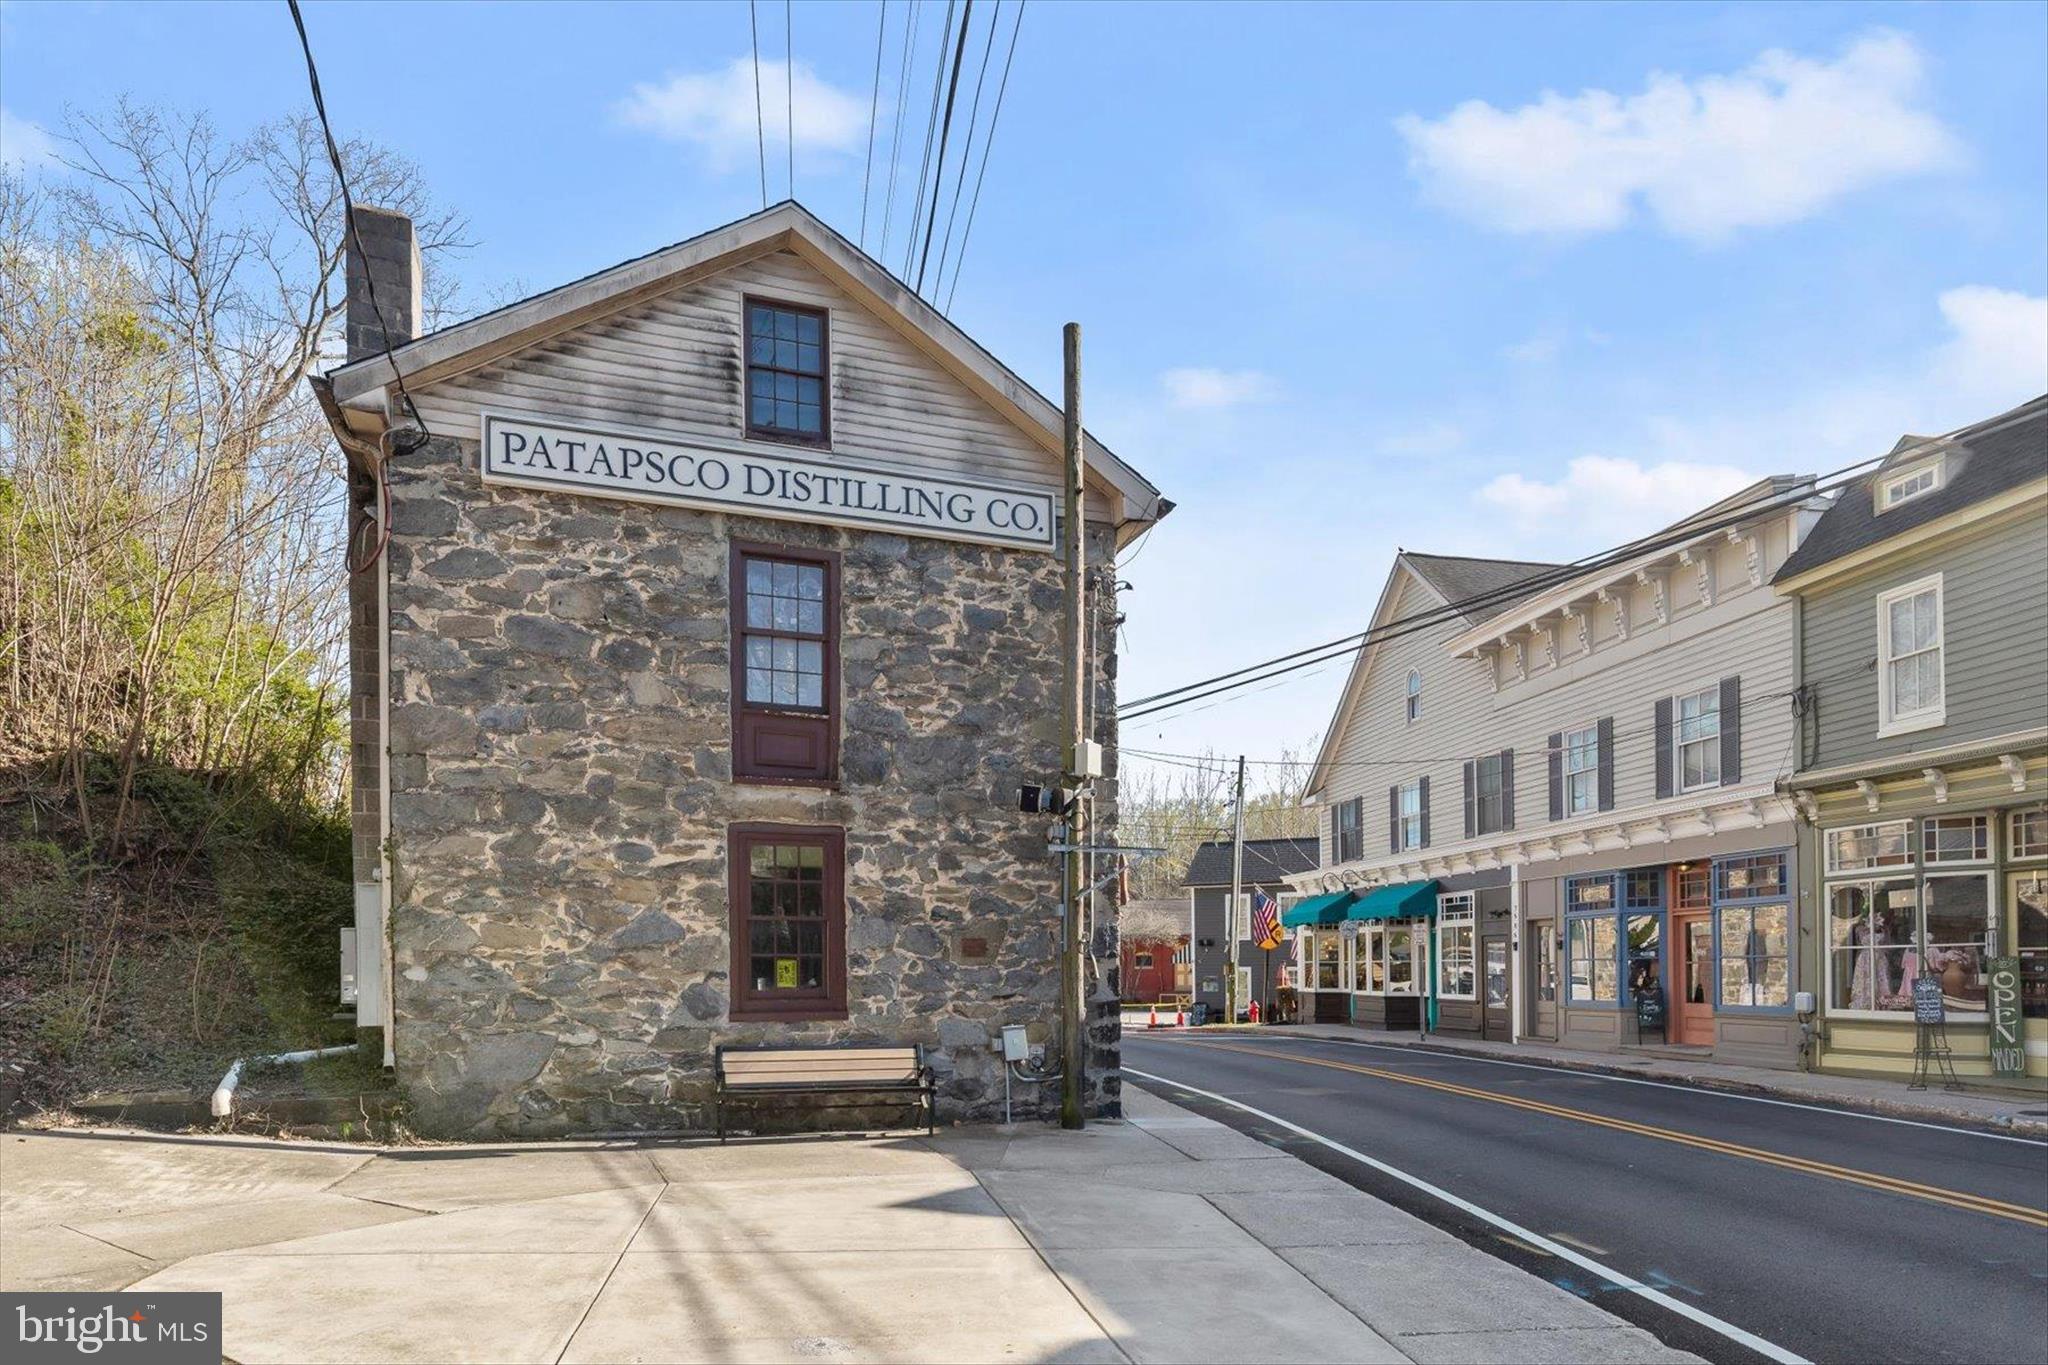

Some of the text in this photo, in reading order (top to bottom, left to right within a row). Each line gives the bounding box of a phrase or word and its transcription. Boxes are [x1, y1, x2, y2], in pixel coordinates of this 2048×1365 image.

[500, 431, 1045, 534] PATAPSCO DISTILLING CO.
[1992, 971, 2016, 1044] OPEN
